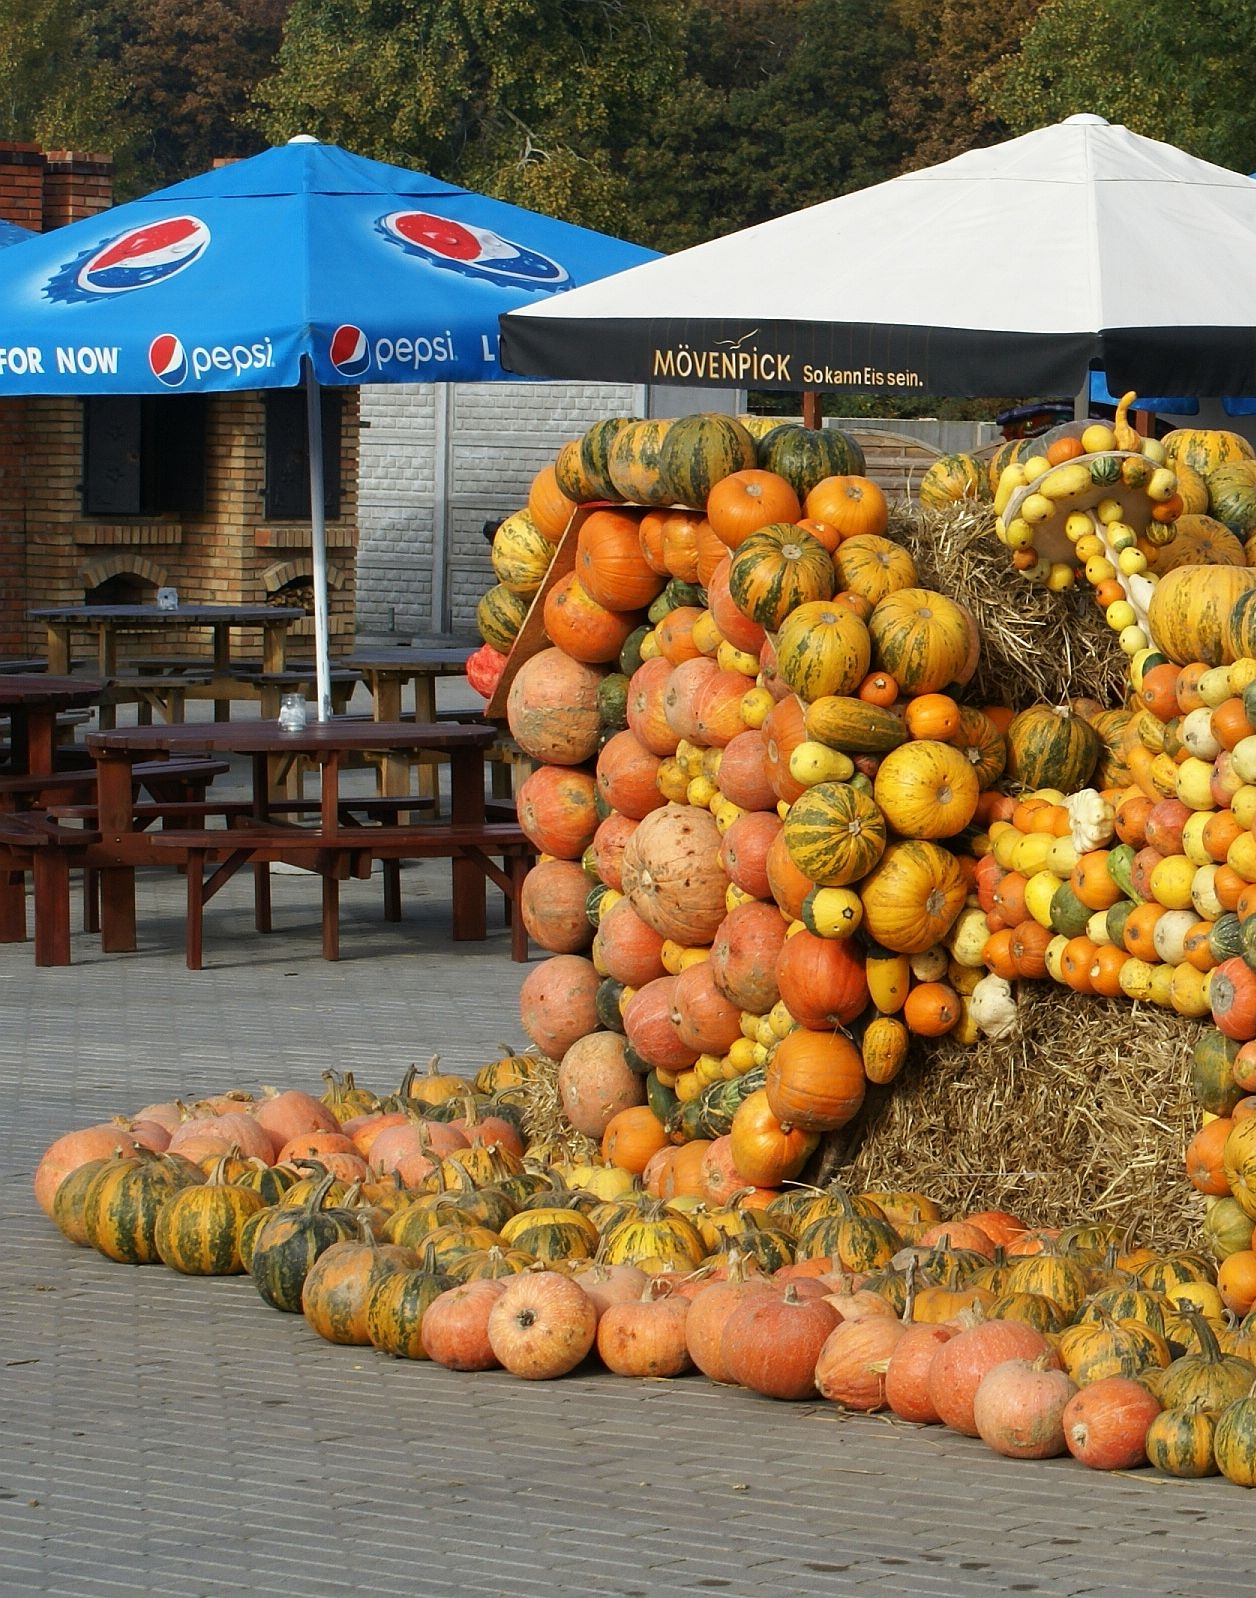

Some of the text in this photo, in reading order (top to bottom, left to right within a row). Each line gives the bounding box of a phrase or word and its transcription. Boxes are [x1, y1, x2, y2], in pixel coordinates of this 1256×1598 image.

[56, 346, 118, 375] NOW
[192, 336, 273, 380] pepsi
[374, 330, 454, 371] pepsi
[480, 334, 500, 362] L
[652, 343, 923, 387] MÖVENPICK So kann Eis sein.
